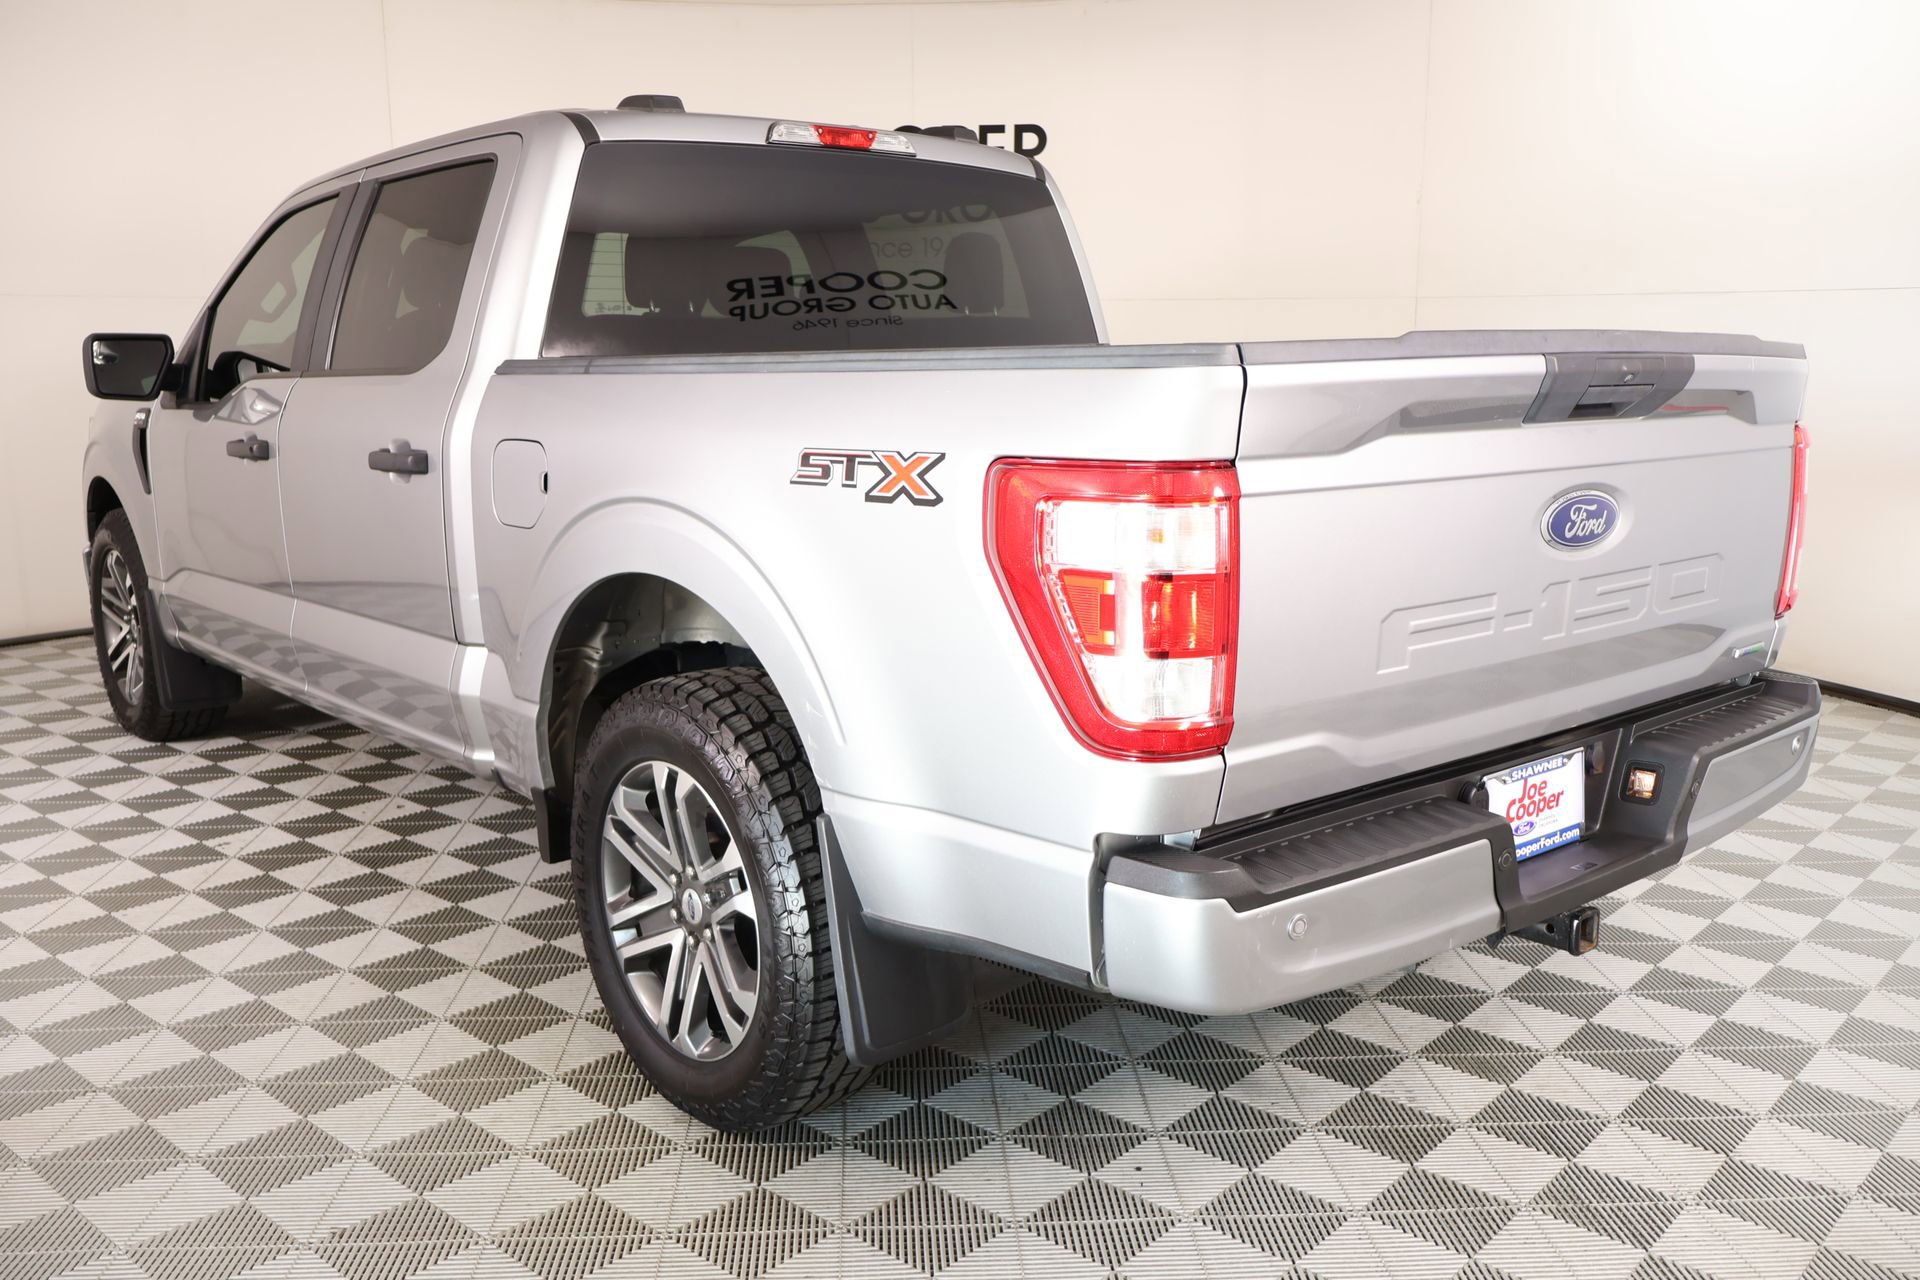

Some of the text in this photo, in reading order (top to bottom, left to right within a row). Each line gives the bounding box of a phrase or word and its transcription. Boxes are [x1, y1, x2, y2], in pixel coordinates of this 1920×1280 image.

[790, 447, 946, 507] STX
[1565, 503, 1608, 539] Ford
[1376, 552, 1724, 674] F-150
[1510, 758, 1563, 782] SHAWNEE
[1505, 790, 1564, 824] Cooper
[1518, 778, 1548, 802] Joe
[1515, 828, 1580, 857] ooperFord.com
